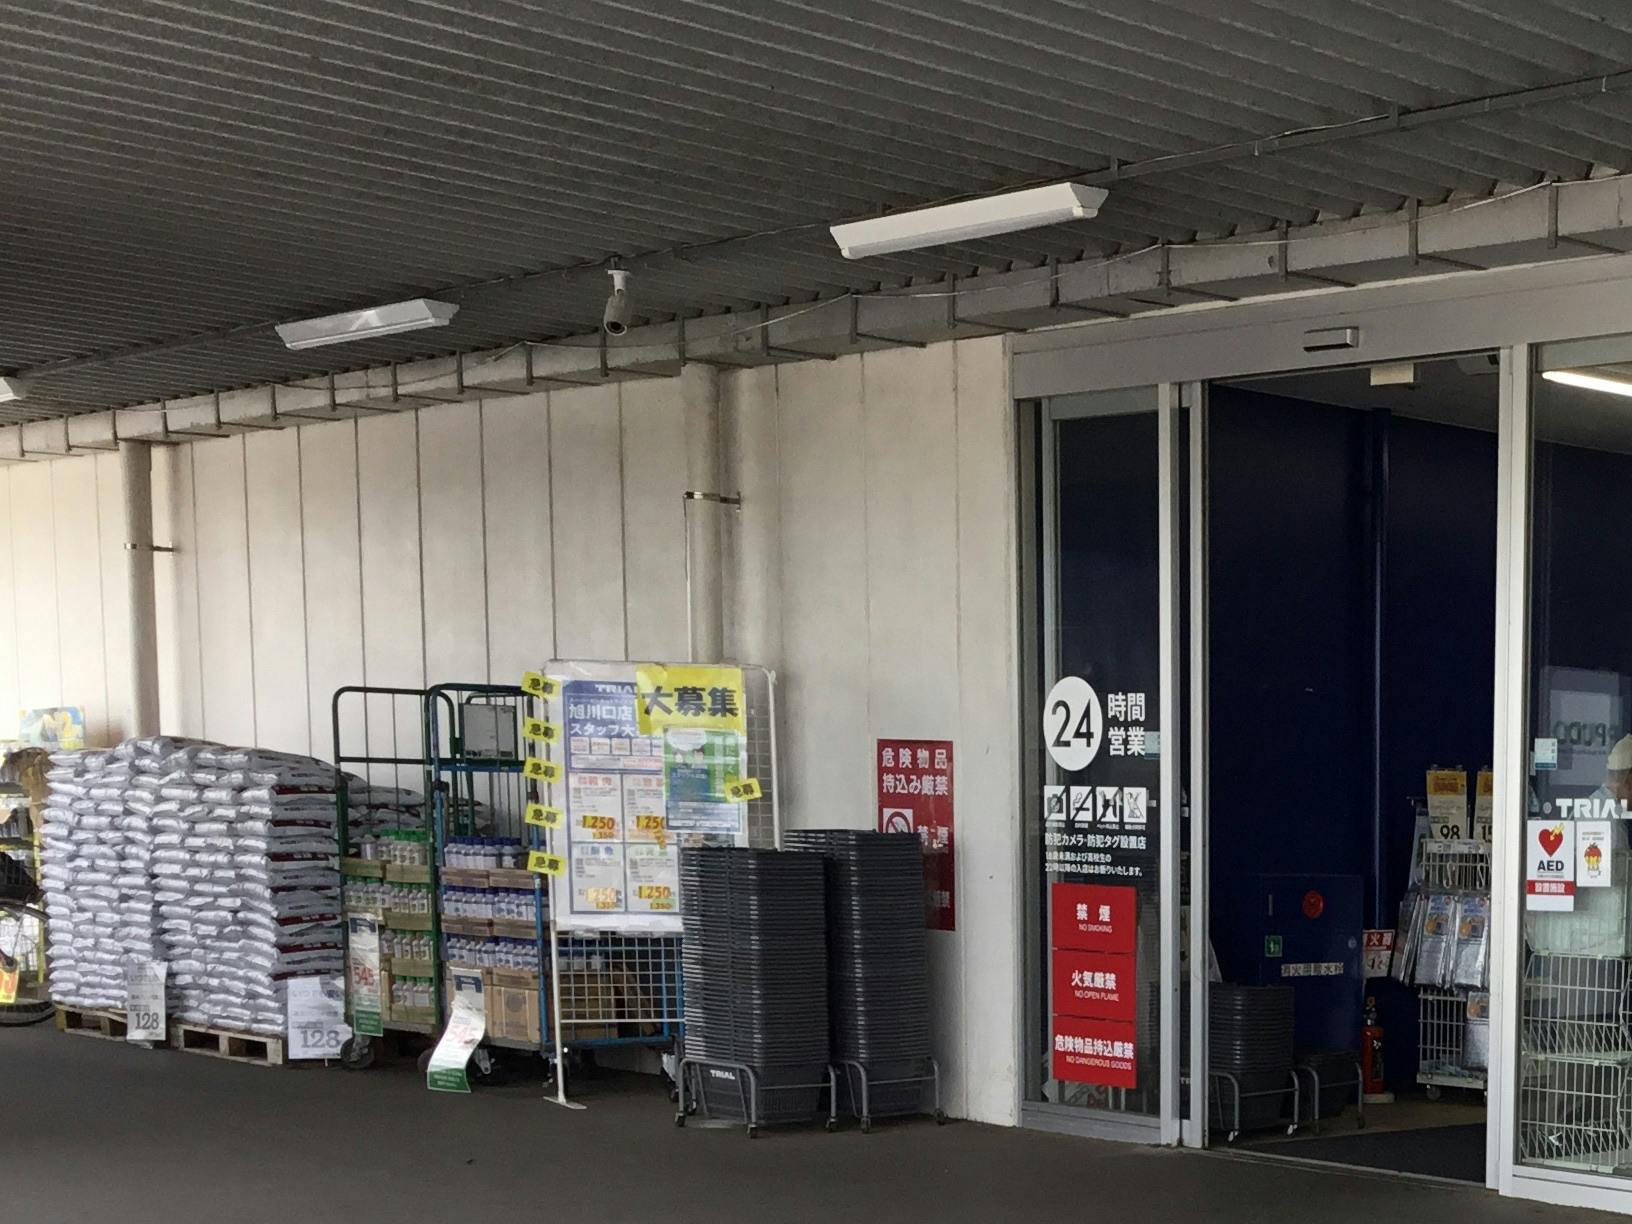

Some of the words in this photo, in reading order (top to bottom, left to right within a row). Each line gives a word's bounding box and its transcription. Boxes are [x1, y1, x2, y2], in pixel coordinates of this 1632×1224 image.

[568, 703, 634, 722] 旭川口店
[643, 685, 740, 719] 大募集
[1107, 692, 1146, 722] 時間
[1051, 698, 1095, 748] 24
[1107, 726, 1146, 757] 営業
[881, 747, 948, 769] 危険物品
[882, 774, 949, 796] 持込み厳禁
[1537, 860, 1565, 872] AED
[1071, 970, 1117, 991] 火気厳禁
[135, 1012, 160, 1030] 128
[300, 1029, 341, 1049] 128
[1054, 1034, 1135, 1060] 危険物品持込厳禁
